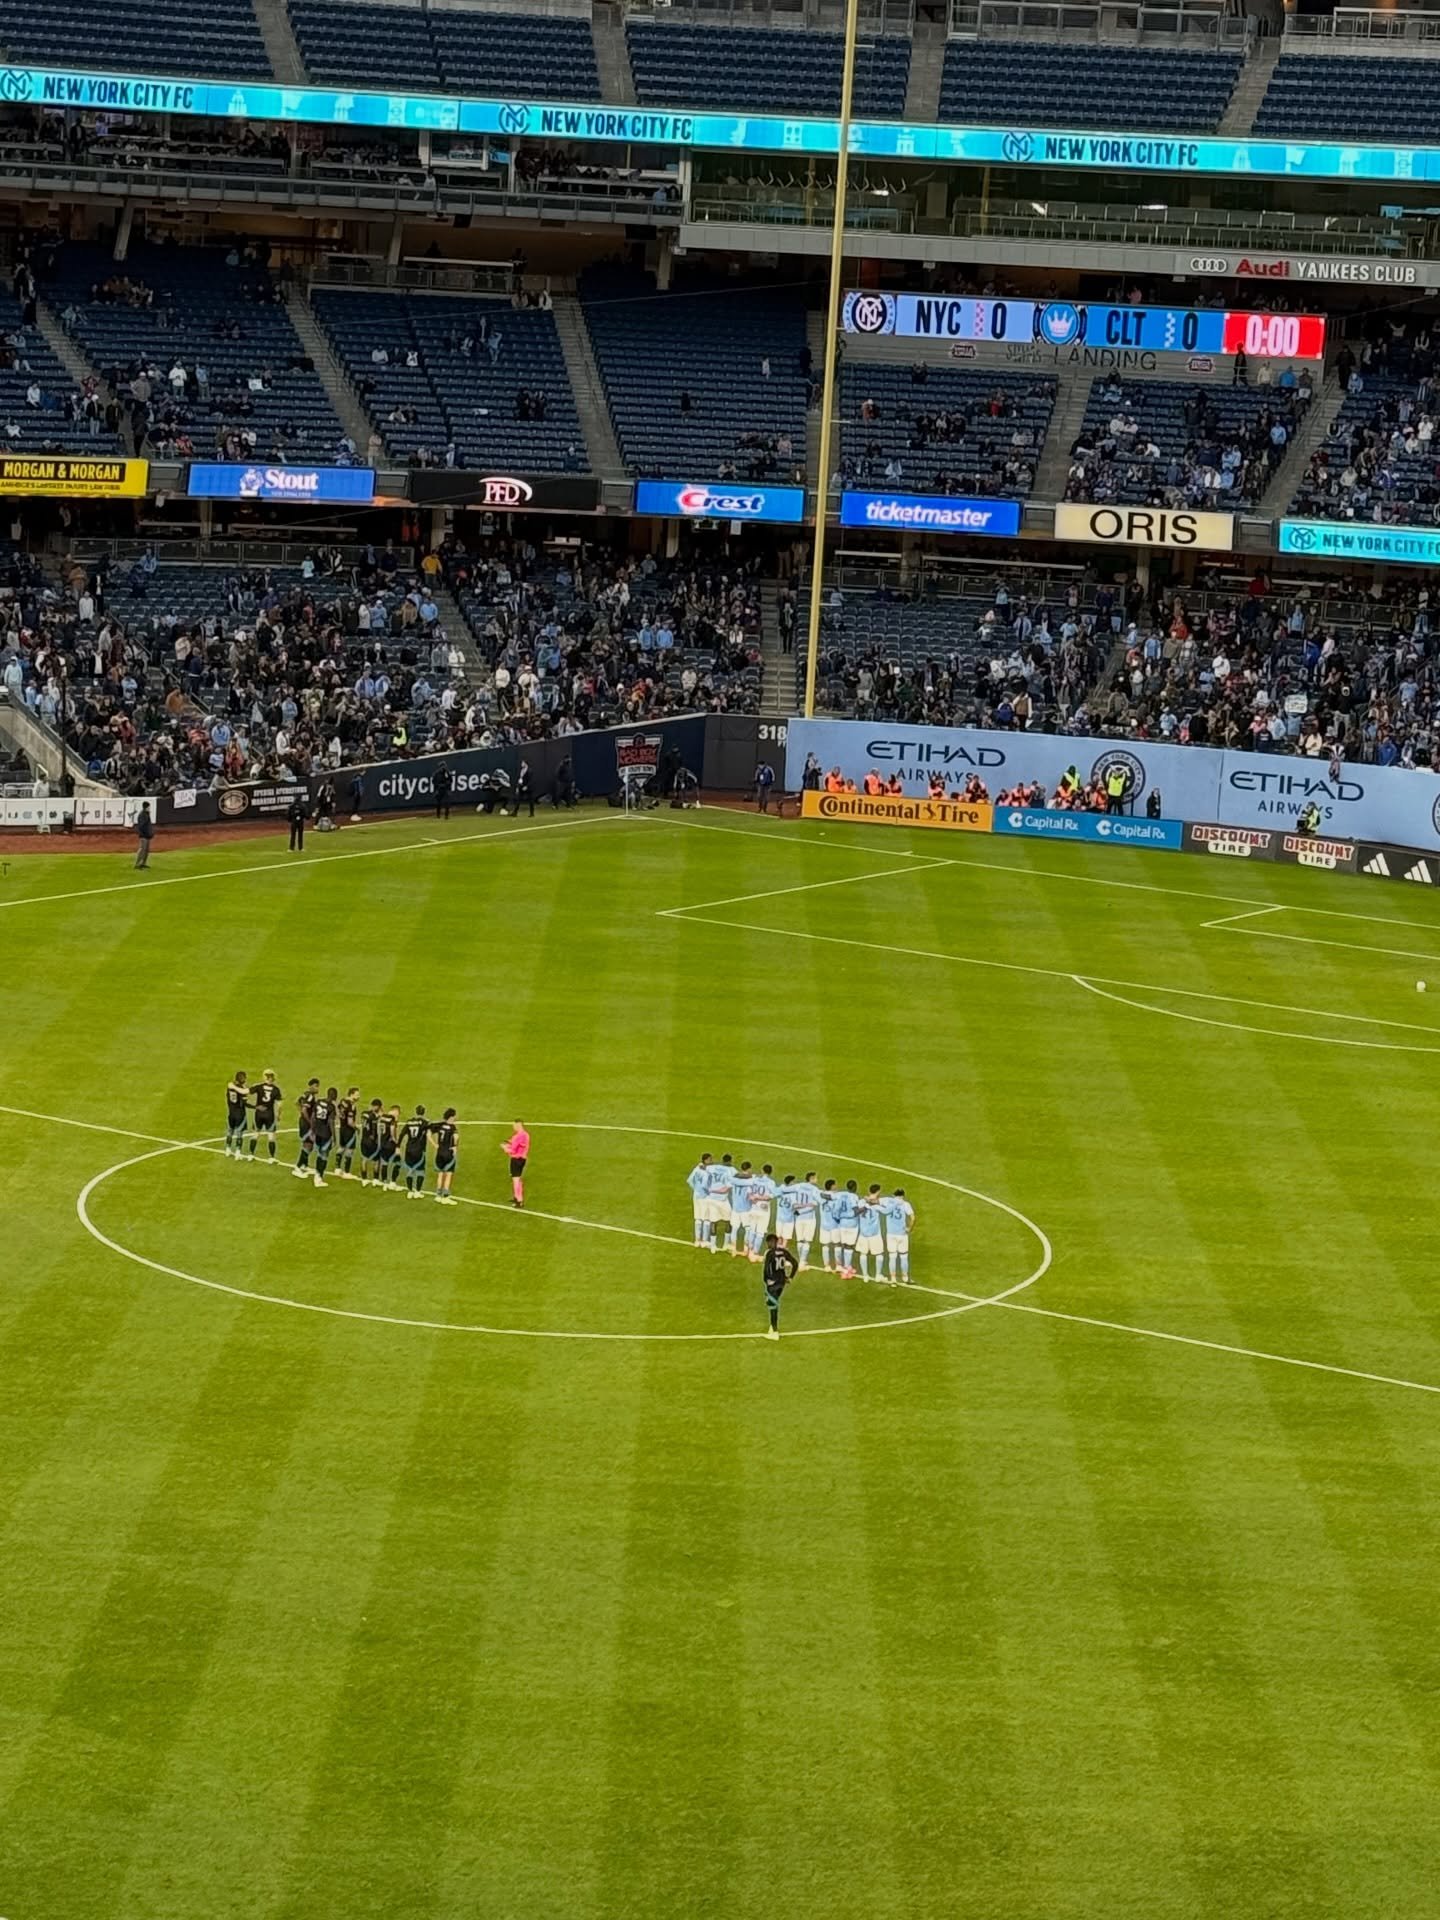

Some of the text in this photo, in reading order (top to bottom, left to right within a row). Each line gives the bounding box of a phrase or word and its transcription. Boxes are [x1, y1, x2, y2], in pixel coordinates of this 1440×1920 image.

[43, 76, 194, 109] NEW YORK CITY FC
[541, 109, 692, 140] NEW YORK CITY FC
[1045, 137, 1198, 166] NEW YORK CITY FC
[1236, 258, 1415, 282] Audi YANKEES CLUB
[915, 299, 961, 336] NYC
[991, 302, 1007, 340] 0
[1106, 309, 1300, 357] CLT 0 0:00
[1054, 346, 1157, 370] LANDING
[3, 461, 120, 480] MORGAN & MORGAN
[265, 469, 319, 490] Stout
[485, 482, 520, 502] PFD
[681, 490, 763, 511] Crest
[866, 500, 992, 527] ticketmaster
[1090, 509, 1197, 545] ORIS
[1322, 533, 1354, 549] NEW
[1357, 537, 1391, 552] YORK
[1394, 539, 1427, 554] CITY
[758, 724, 787, 740] 318
[866, 740, 1006, 767] ETIHAD
[1230, 770, 1365, 801] ETIHAD
[818, 795, 979, 823] Continental Tire
[1025, 815, 1079, 831] Capital Rx
[1113, 823, 1166, 839] Capital Rx
[1192, 825, 1271, 848] DISCOUNT
[1211, 841, 1246, 855] TIRE
[1284, 836, 1355, 861] DISCOUNT
[1302, 853, 1332, 867] TIRE
